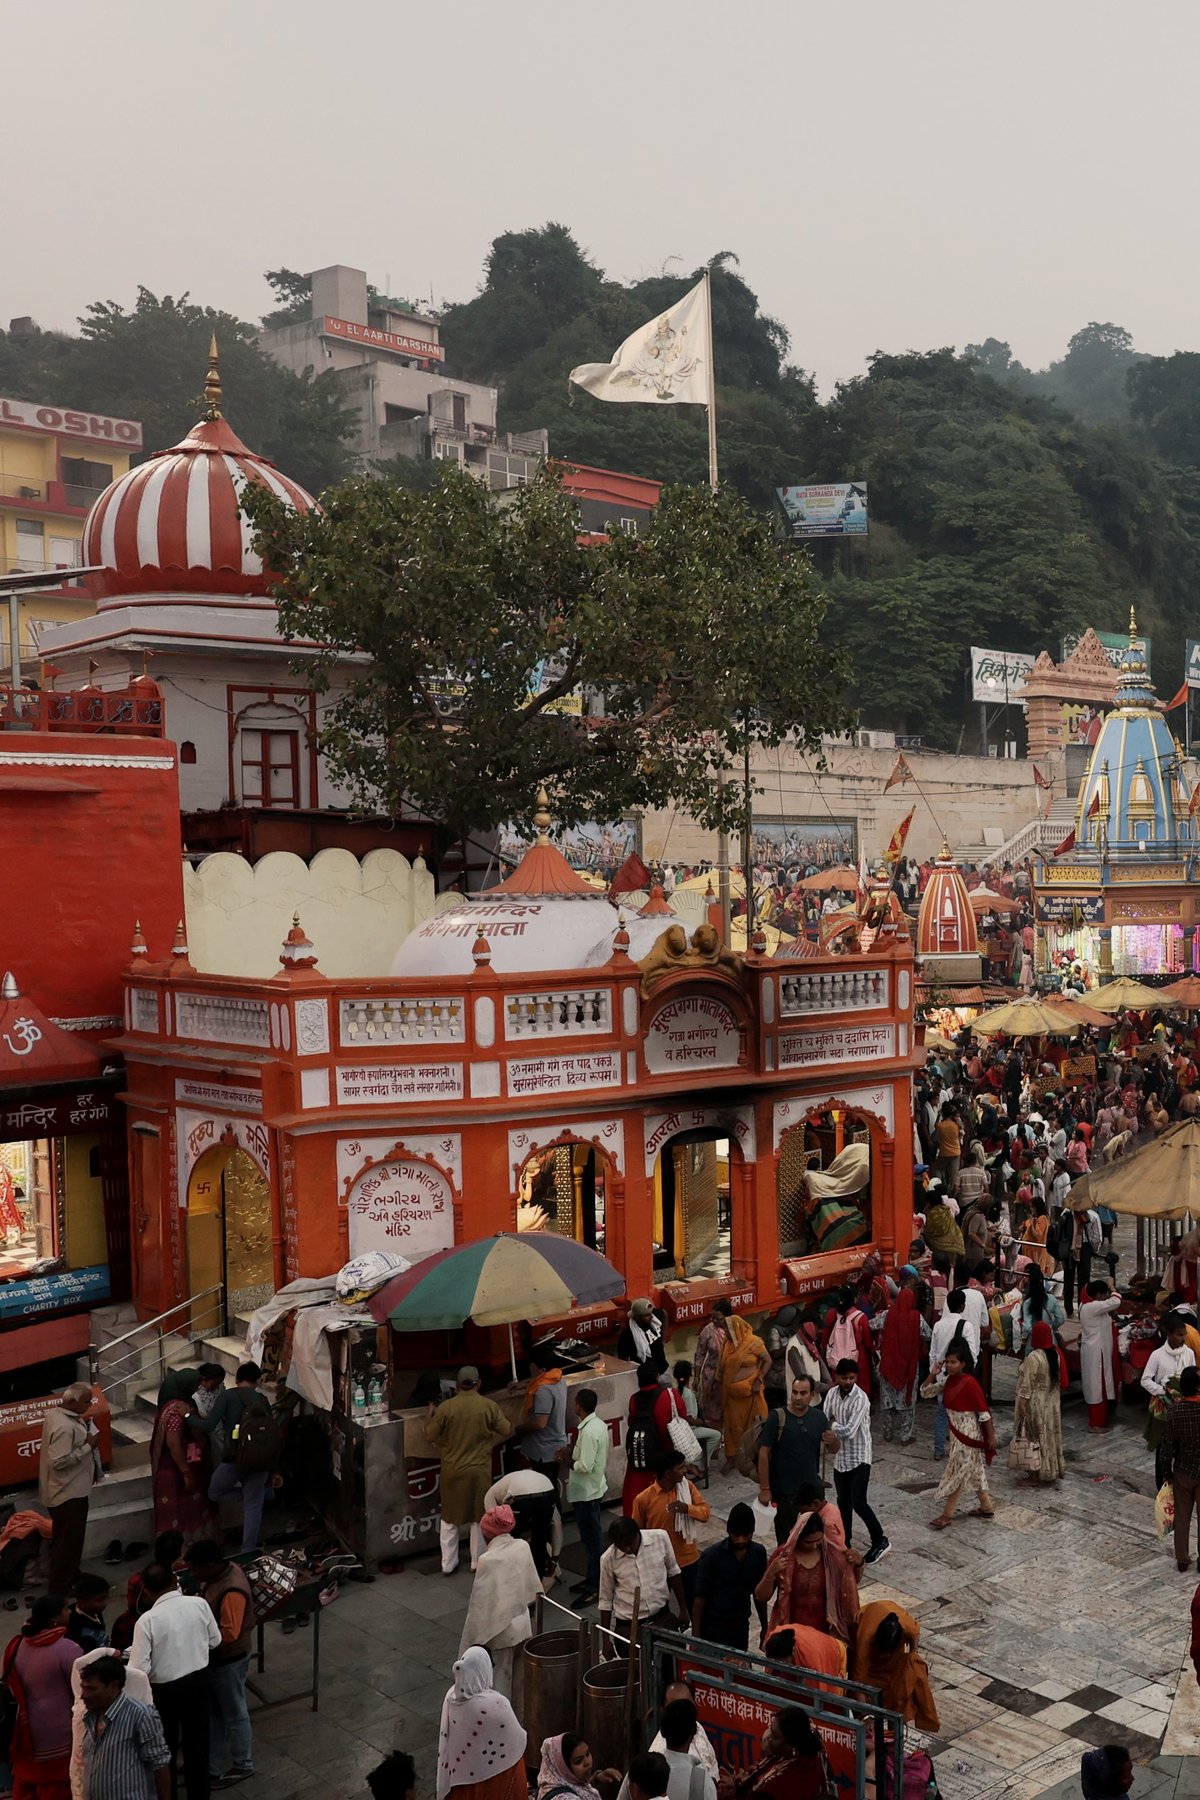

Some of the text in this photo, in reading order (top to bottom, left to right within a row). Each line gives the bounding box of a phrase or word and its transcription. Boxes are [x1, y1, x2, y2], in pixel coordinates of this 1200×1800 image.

[363, 328, 393, 344] AARTI
[397, 336, 440, 355] DARSHAN
[36, 408, 139, 441] OSHO
[476, 903, 543, 917] मन्दिर
[669, 1025, 718, 1042] राजा भगीरथ
[805, 1038, 813, 1047] च
[836, 1034, 843, 1044] च
[845, 1030, 870, 1045] ददासि
[665, 1044, 717, 1061] व हरिचरन
[830, 1049, 844, 1058] सदा
[562, 1060, 574, 1071] तव
[577, 1058, 591, 1070] पाद
[343, 1086, 360, 1097] सागर
[77, 1094, 94, 1107] हर
[7, 1104, 57, 1129] मन्दिर
[70, 1110, 88, 1124] हर
[646, 1112, 681, 1155] आरती
[391, 1164, 415, 1179] ગંગા
[416, 1170, 440, 1192] માતા
[374, 1190, 421, 1206] ભગીરથ
[392, 1208, 433, 1221] હરિચરણ
[385, 1223, 411, 1236] મંદિર
[23, 1295, 81, 1314] CHARITY BOX
[576, 1317, 608, 1334] दान पात्र
[390, 1515, 418, 1543] श्री
[694, 1688, 707, 1706] हर
[708, 1688, 720, 1711] की
[737, 1695, 754, 1720] क्षेत्र
[755, 1702, 763, 1722] में
